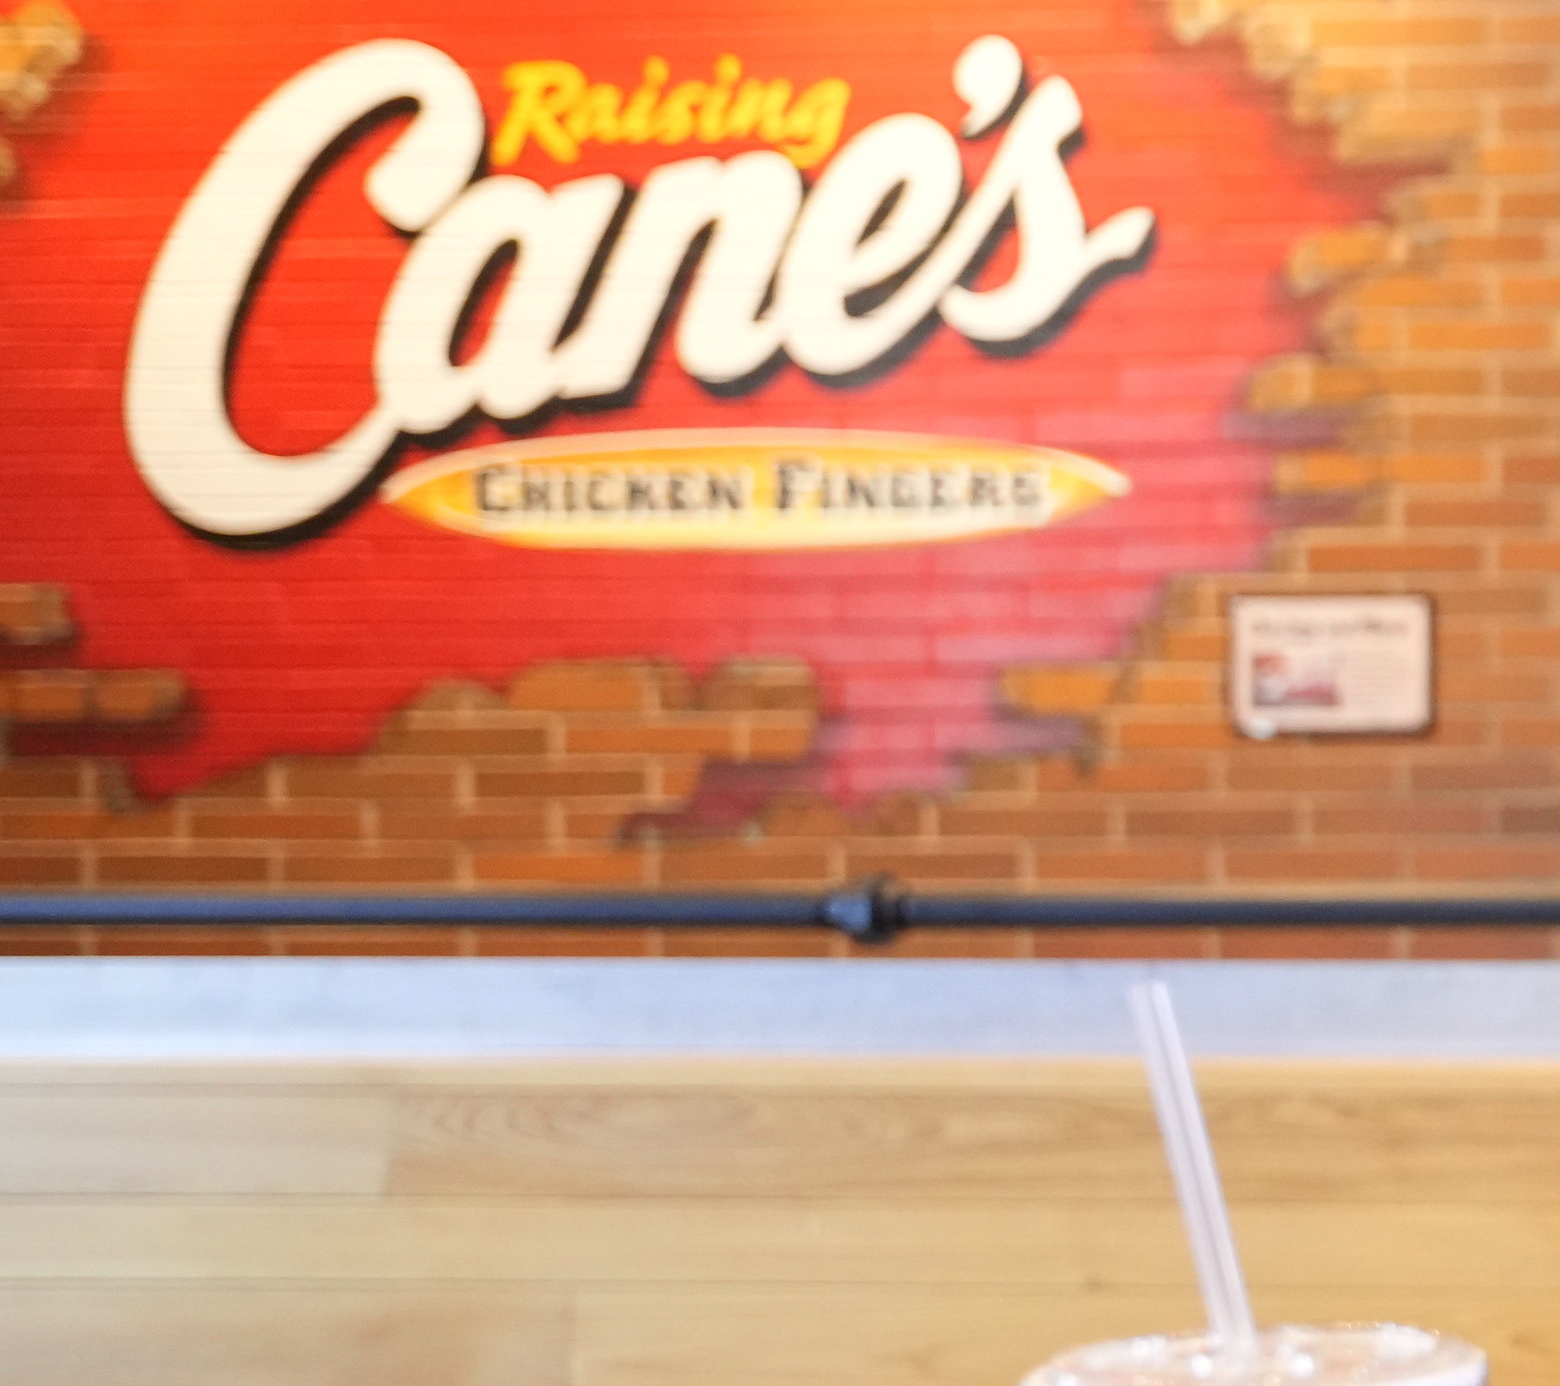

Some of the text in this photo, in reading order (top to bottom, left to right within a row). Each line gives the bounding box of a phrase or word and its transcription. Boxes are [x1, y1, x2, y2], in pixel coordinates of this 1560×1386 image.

[492, 58, 851, 163] Raising
[124, 37, 1154, 533] Cane's
[474, 459, 1043, 518] CHICKEN FINGERS
